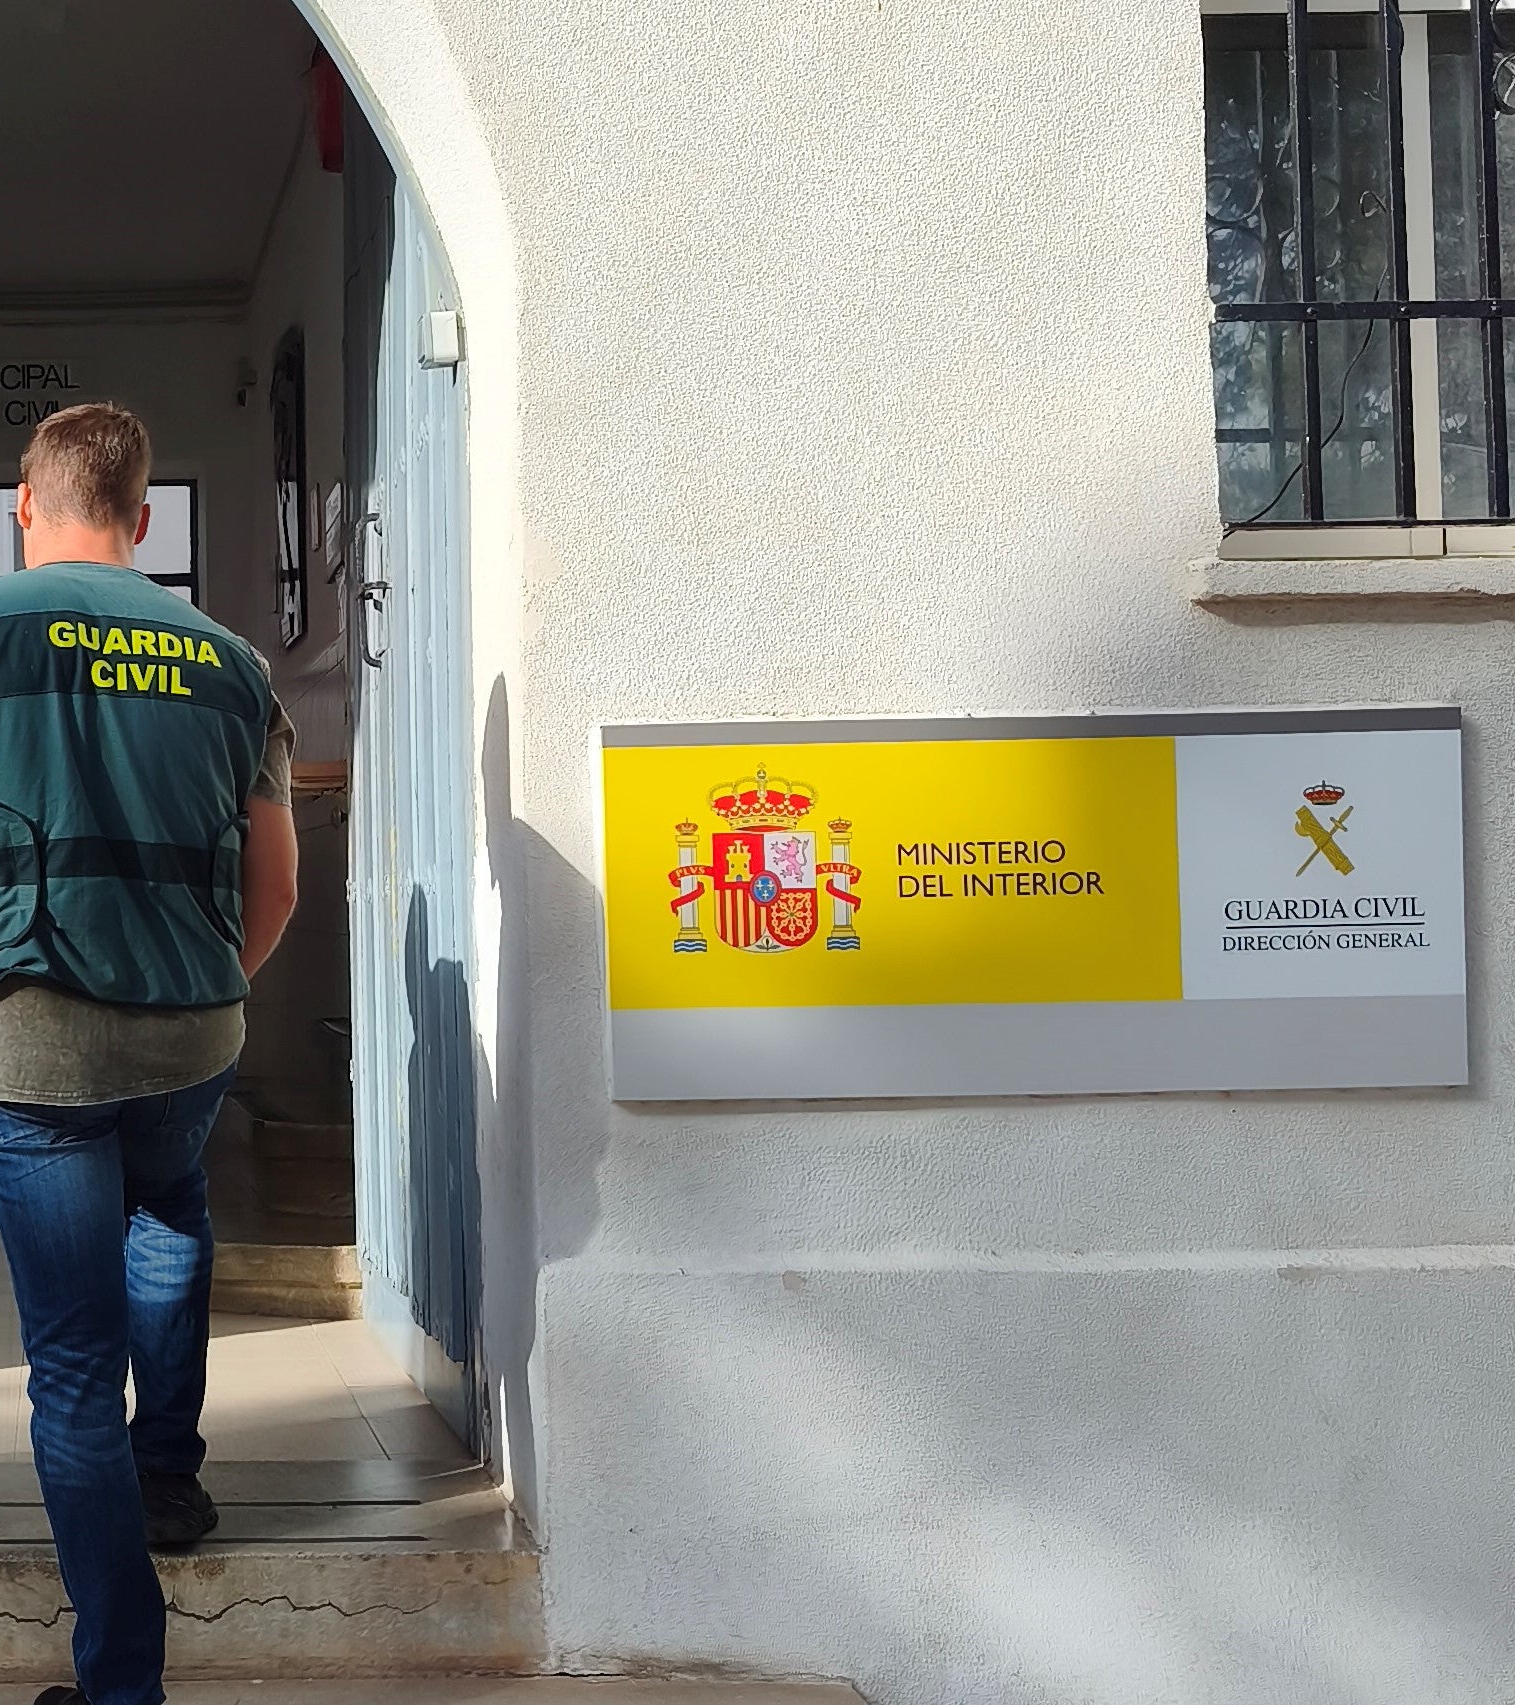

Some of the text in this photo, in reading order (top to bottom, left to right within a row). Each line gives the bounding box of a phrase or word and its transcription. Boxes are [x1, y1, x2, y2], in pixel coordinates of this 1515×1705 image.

[48, 621, 223, 668] GUARDIA
[91, 659, 192, 696] CIVIL
[897, 840, 1066, 865] MINISTERIO
[820, 864, 858, 877] VLTRA
[898, 871, 1105, 898] DEL INTERIOR
[1224, 897, 1425, 921] GUARDIA CIVIL
[1222, 930, 1430, 951] DIRECCIÓN GENERAL
